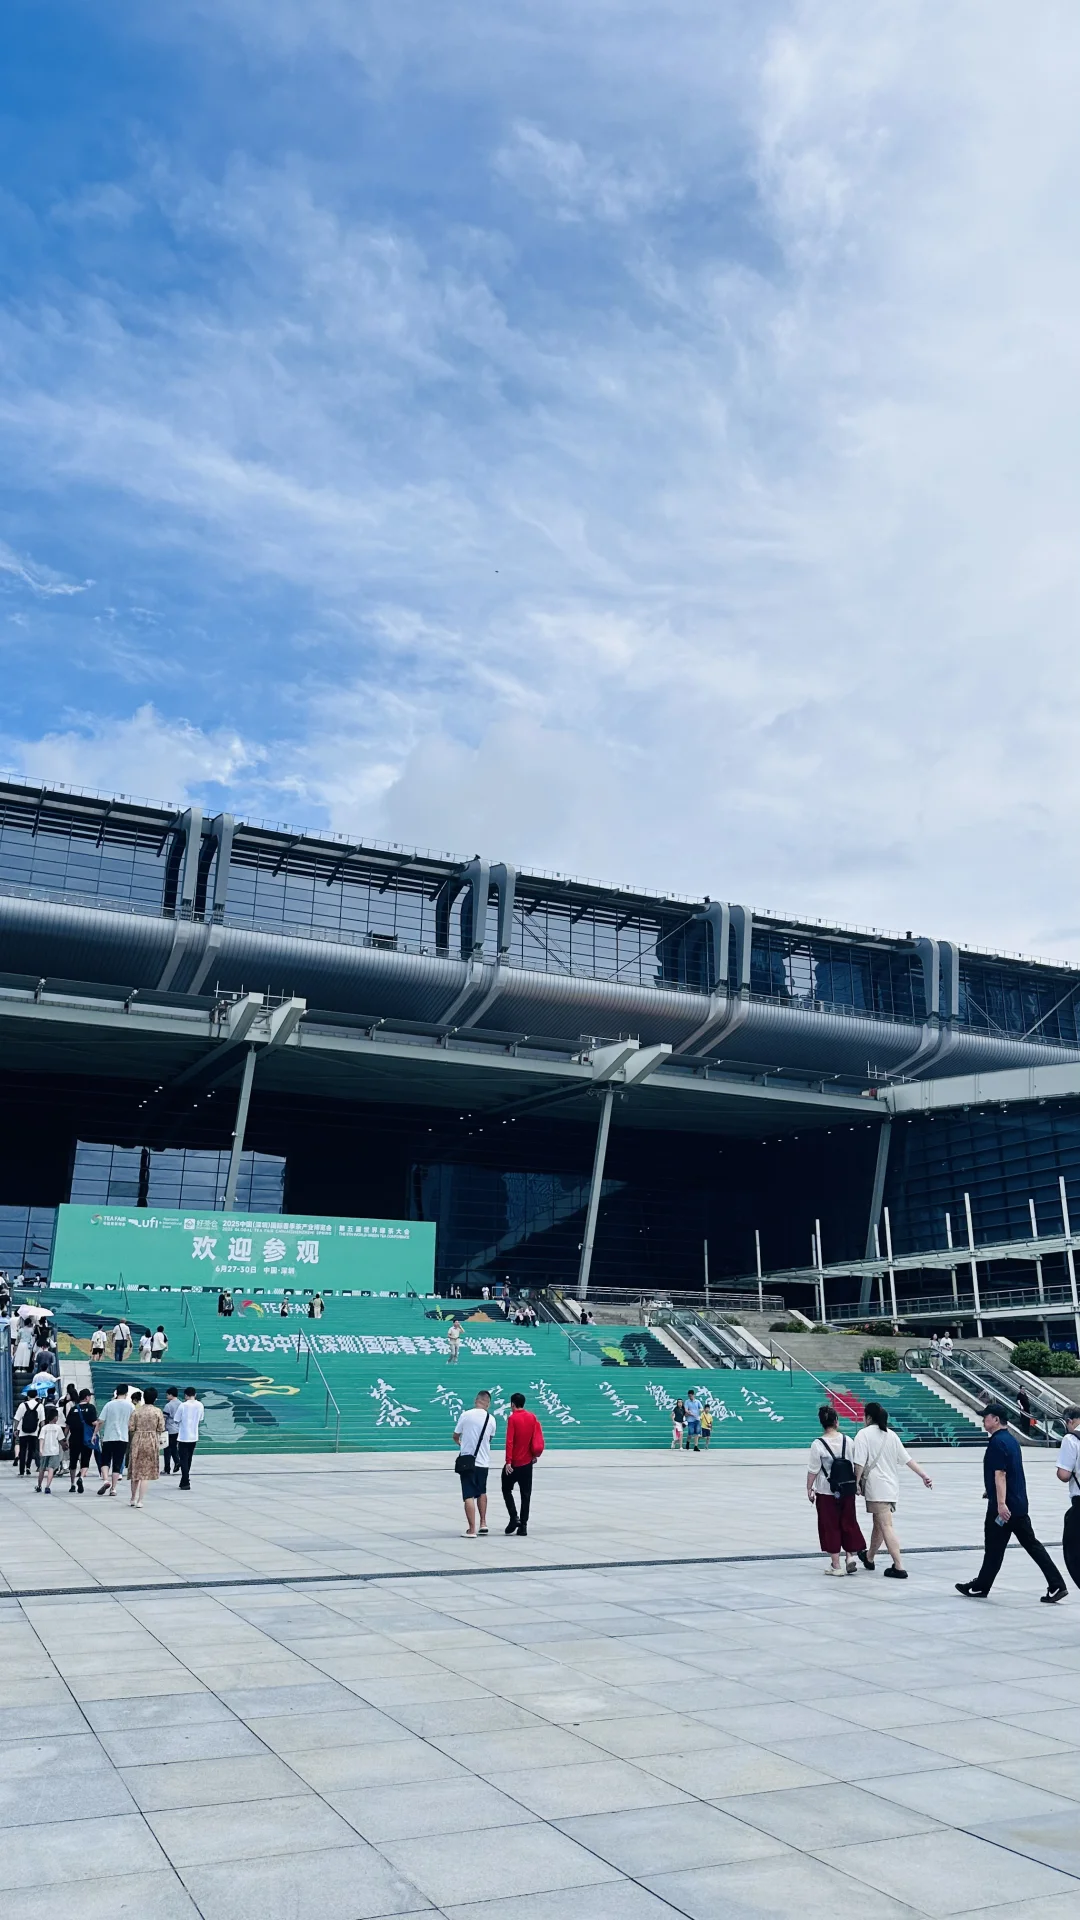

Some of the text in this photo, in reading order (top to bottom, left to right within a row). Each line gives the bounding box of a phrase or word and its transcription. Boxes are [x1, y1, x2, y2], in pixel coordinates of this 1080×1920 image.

[191, 1235, 320, 1264] 欢迎参观
[215, 1265, 257, 1274] 6月27-30日
